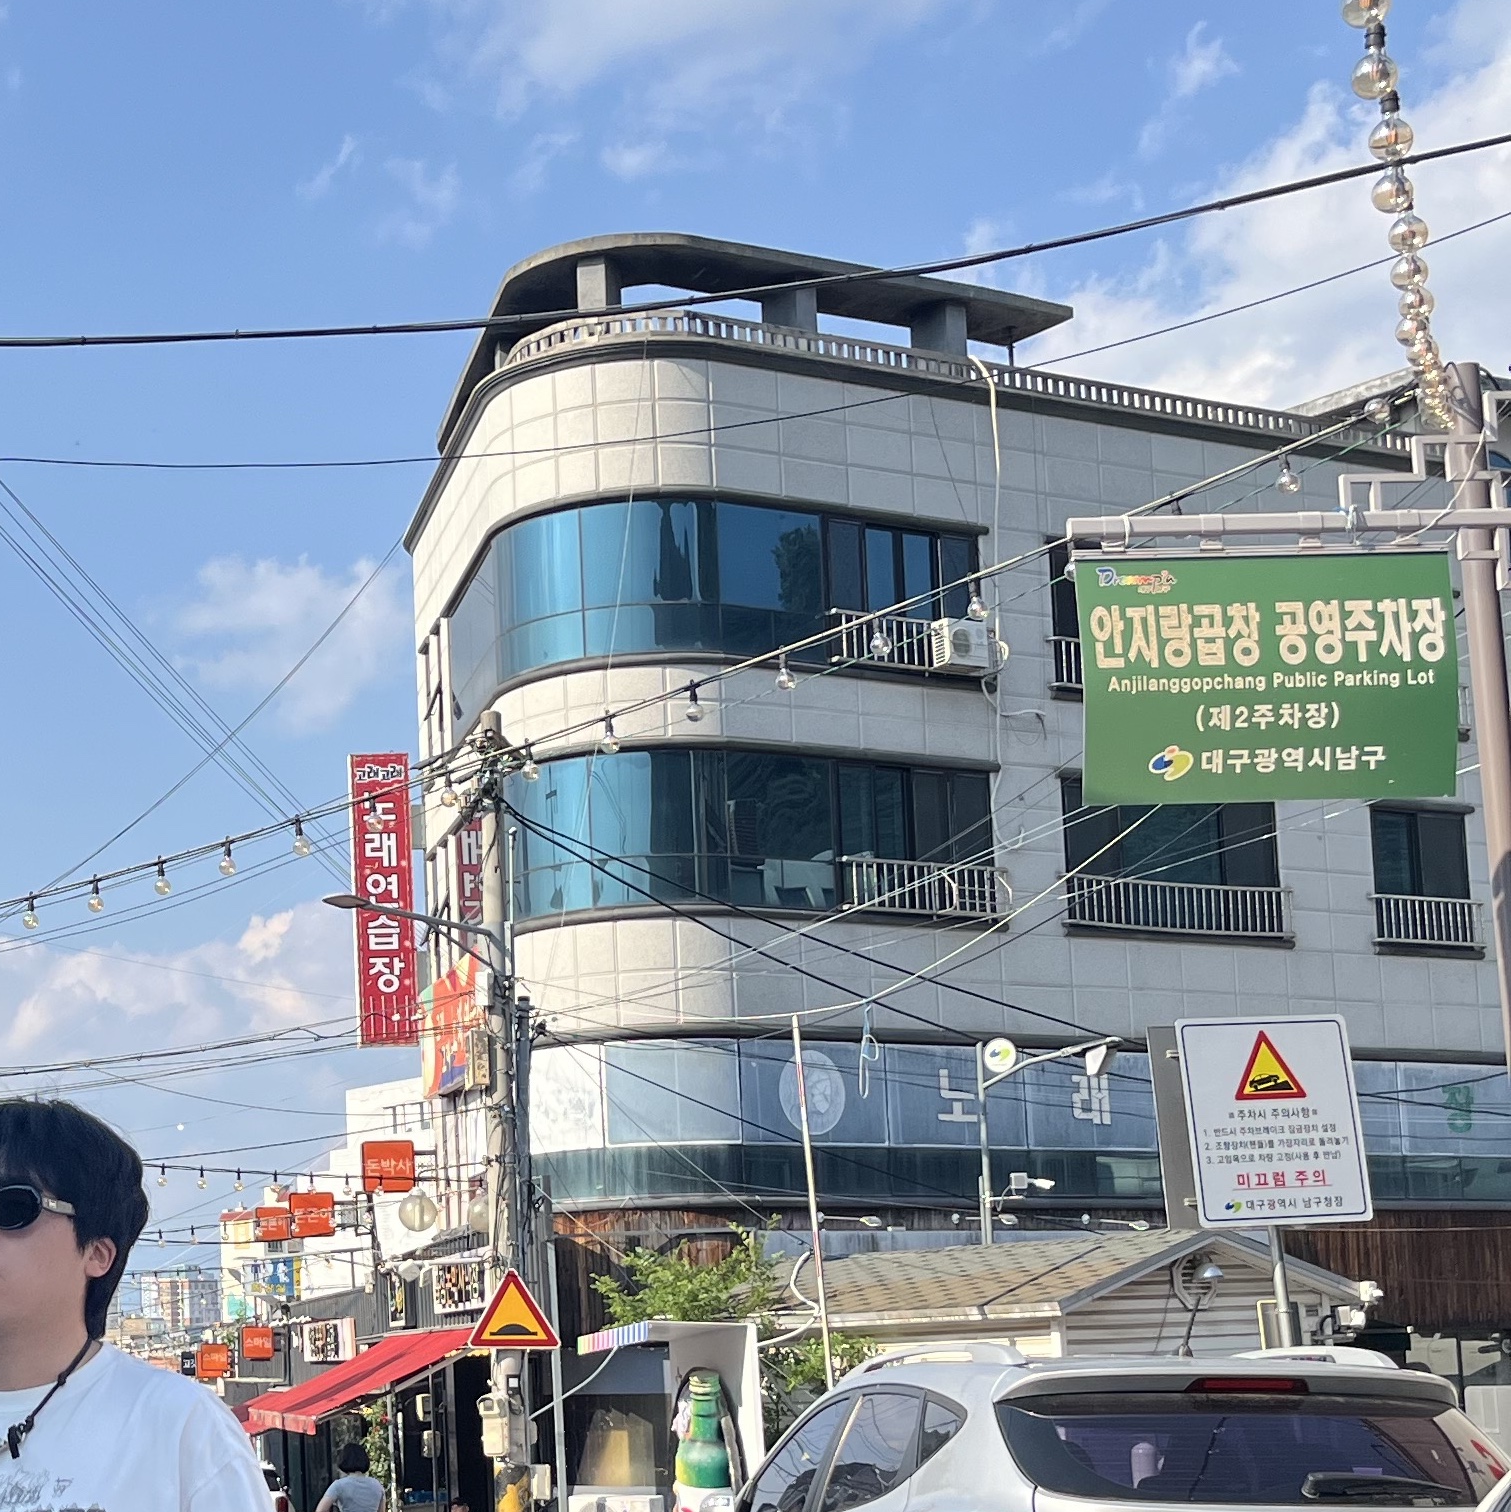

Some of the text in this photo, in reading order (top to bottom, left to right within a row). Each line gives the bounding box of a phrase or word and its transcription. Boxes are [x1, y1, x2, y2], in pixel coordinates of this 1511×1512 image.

[1090, 597, 1446, 669] 안지랑곱창 공영주차장
[1107, 668, 1435, 694] Anjilanggopchang Public Parking Lot
[1196, 702, 1340, 731] (제2주차장)
[1201, 745, 1386, 774] 대구광역시남구
[356, 764, 402, 781] 고래고래
[362, 792, 405, 993] 노래연습장
[1237, 1107, 1310, 1120] 주차시 주의사항
[1214, 1127, 1237, 1137] 반드시
[366, 1158, 411, 1176] 돈박사
[1237, 1169, 1327, 1188] 미끄럼 주의
[1246, 1196, 1343, 1211] 대구광역시 남구청장
